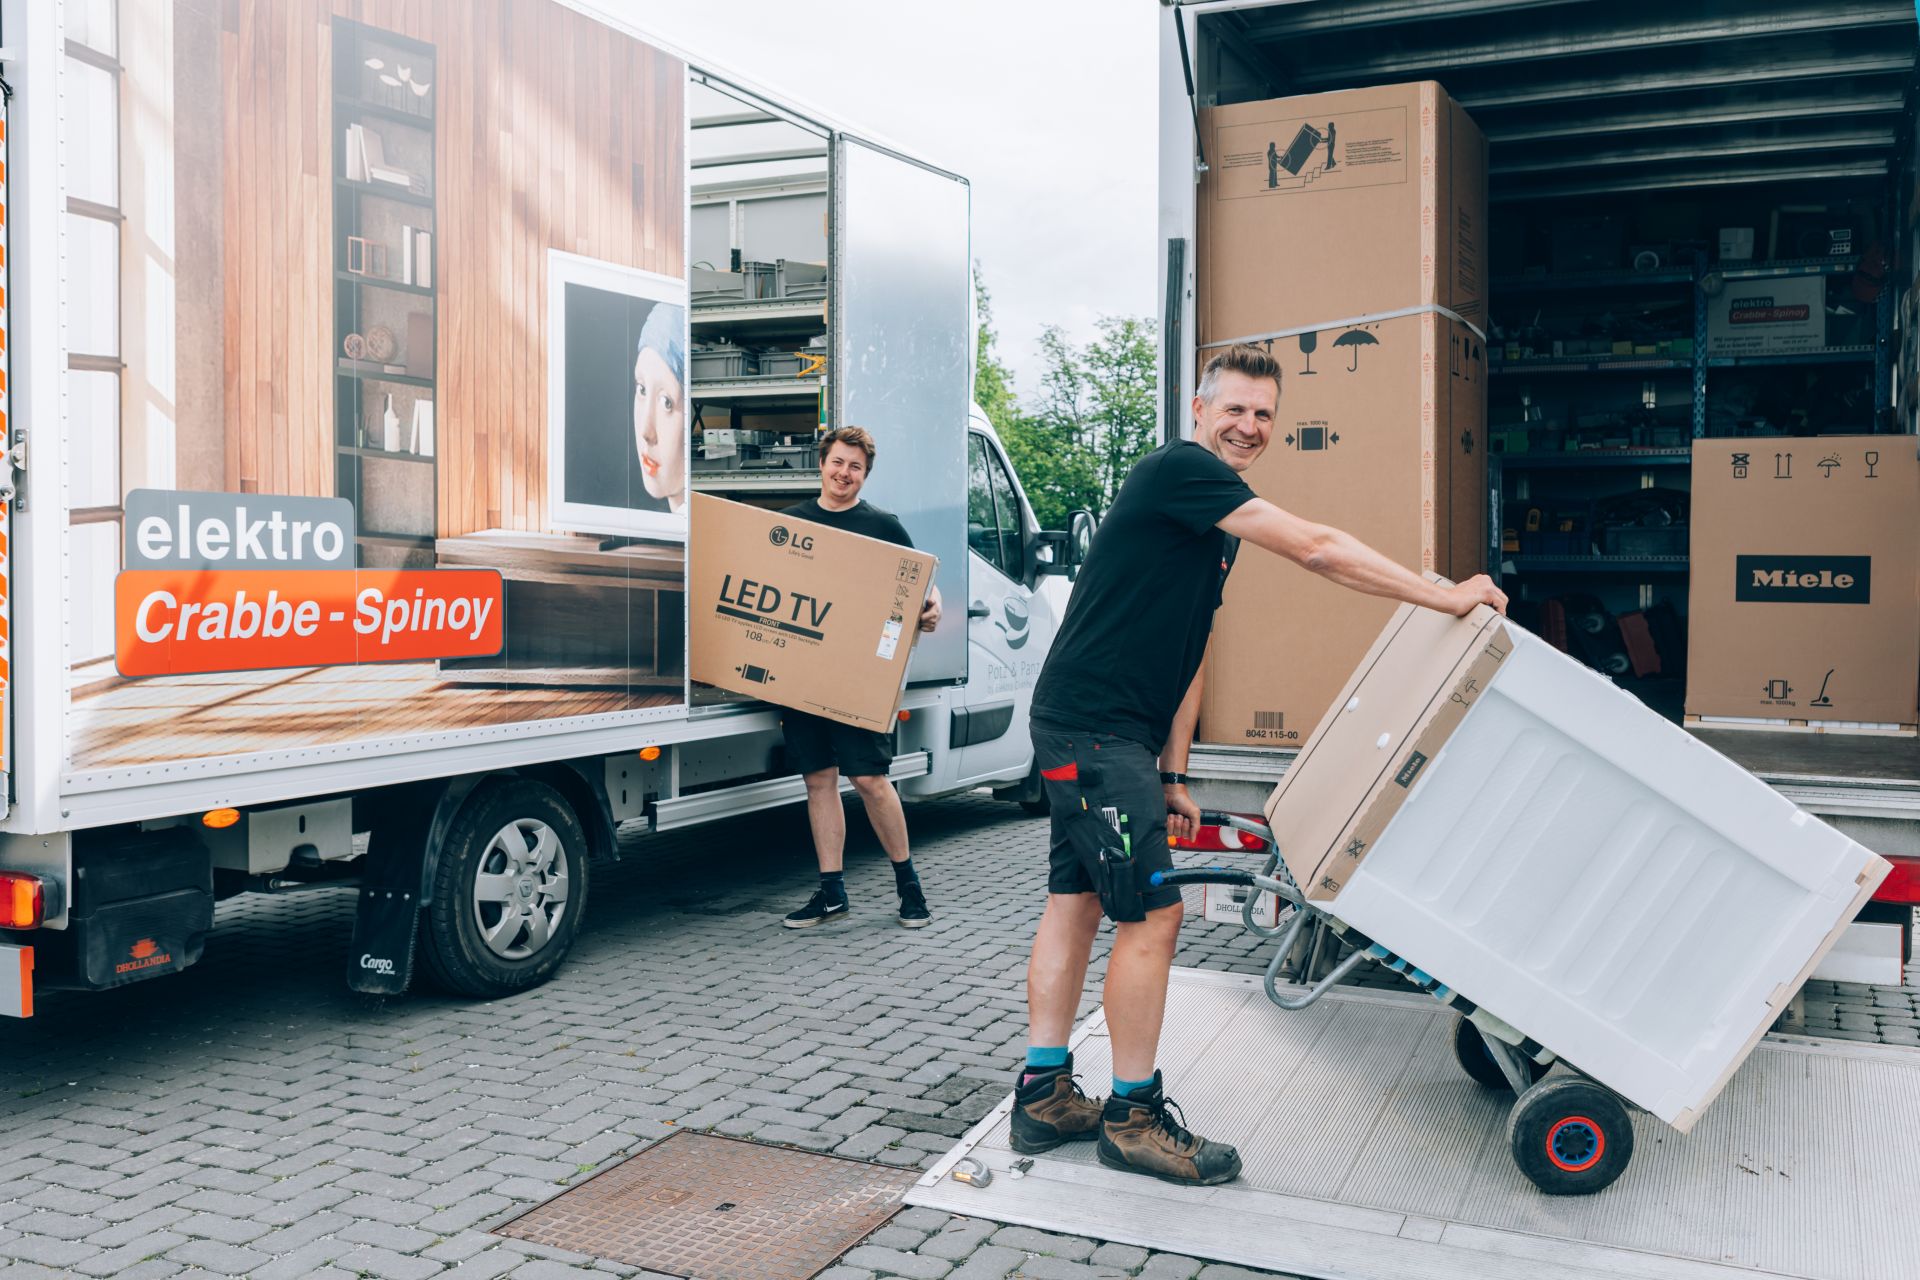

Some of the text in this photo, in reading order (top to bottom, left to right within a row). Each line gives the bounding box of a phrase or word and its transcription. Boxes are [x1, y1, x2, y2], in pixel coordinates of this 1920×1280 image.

[136, 504, 345, 561] elektro
[791, 532, 814, 551] LG
[1752, 569, 1854, 589] Miele
[719, 574, 833, 628] LED TV
[135, 590, 320, 643] Crabbe
[352, 587, 493, 645] Spinoy
[759, 617, 780, 628] FRONT
[1246, 729, 1298, 739] 8042 115-00
[1216, 903, 1265, 916] DHOLLDIA
[115, 953, 171, 973] DHOLLANDIA
[360, 953, 393, 974] Cargo
